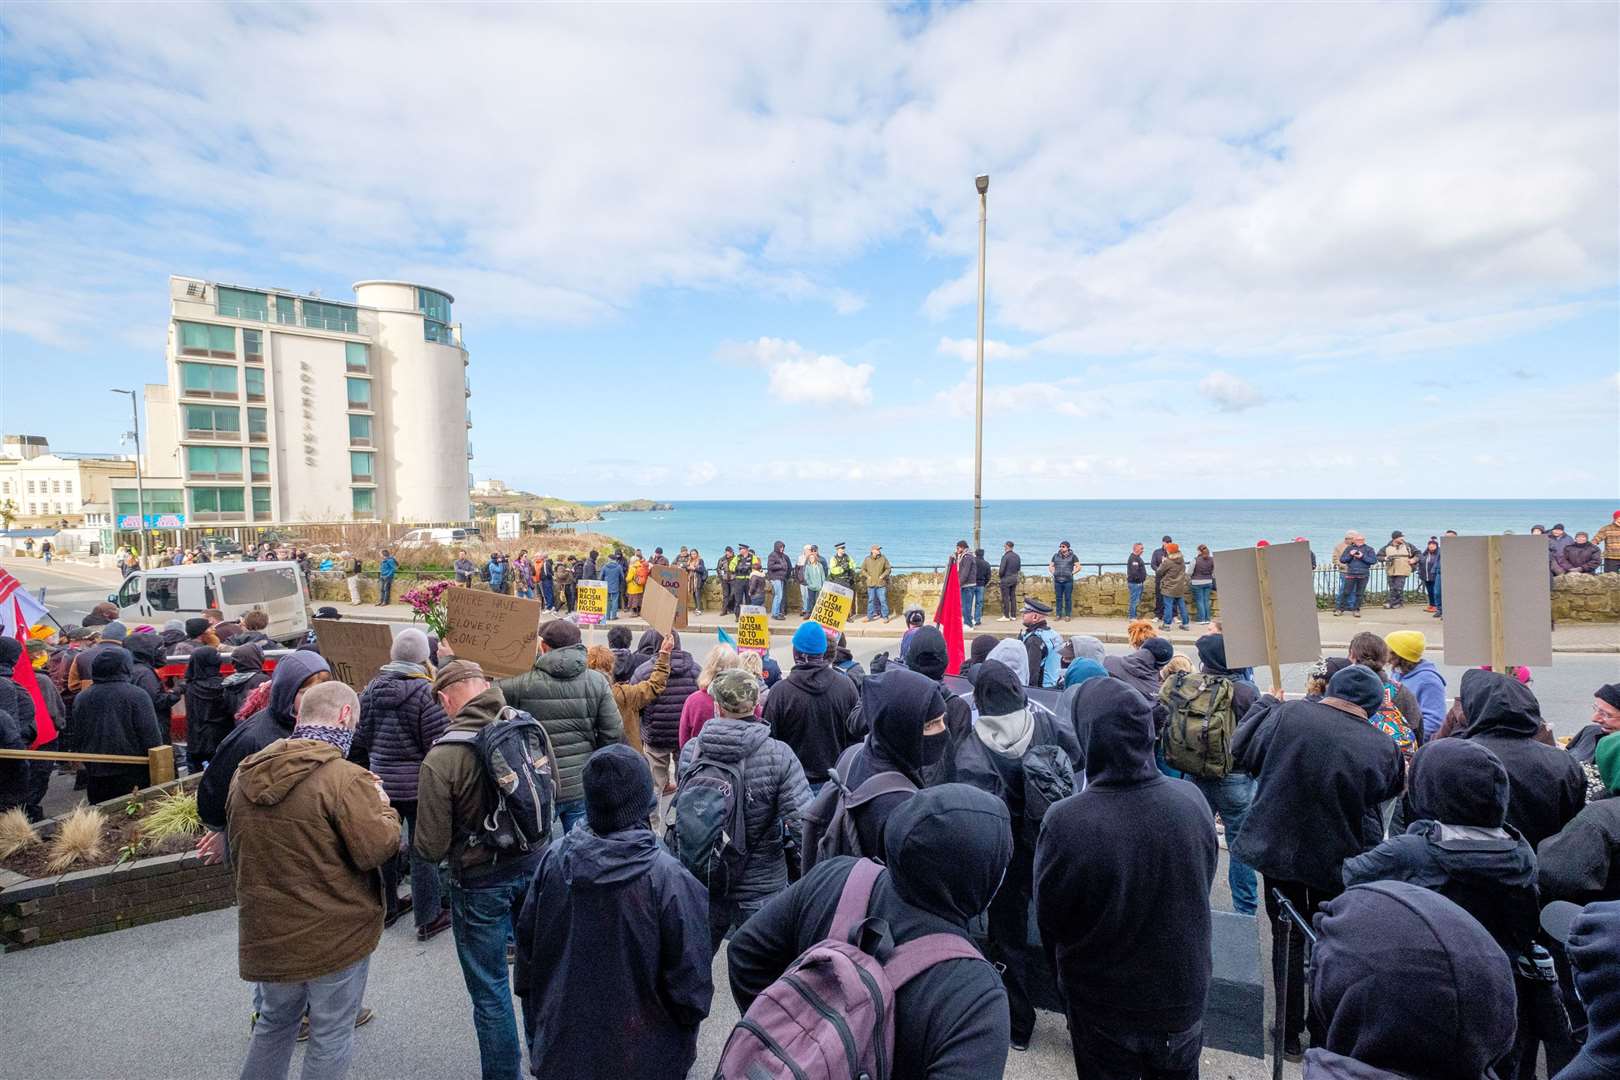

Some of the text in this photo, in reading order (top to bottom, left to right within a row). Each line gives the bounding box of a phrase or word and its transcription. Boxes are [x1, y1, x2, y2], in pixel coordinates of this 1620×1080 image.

[450, 592, 520, 612] WHERE HAVE
[829, 594, 838, 602] TO
[454, 607, 507, 622] ALL THE
[824, 608, 834, 617] TO
[448, 618, 500, 633] FLOWERS
[814, 614, 840, 628] ASCISM
